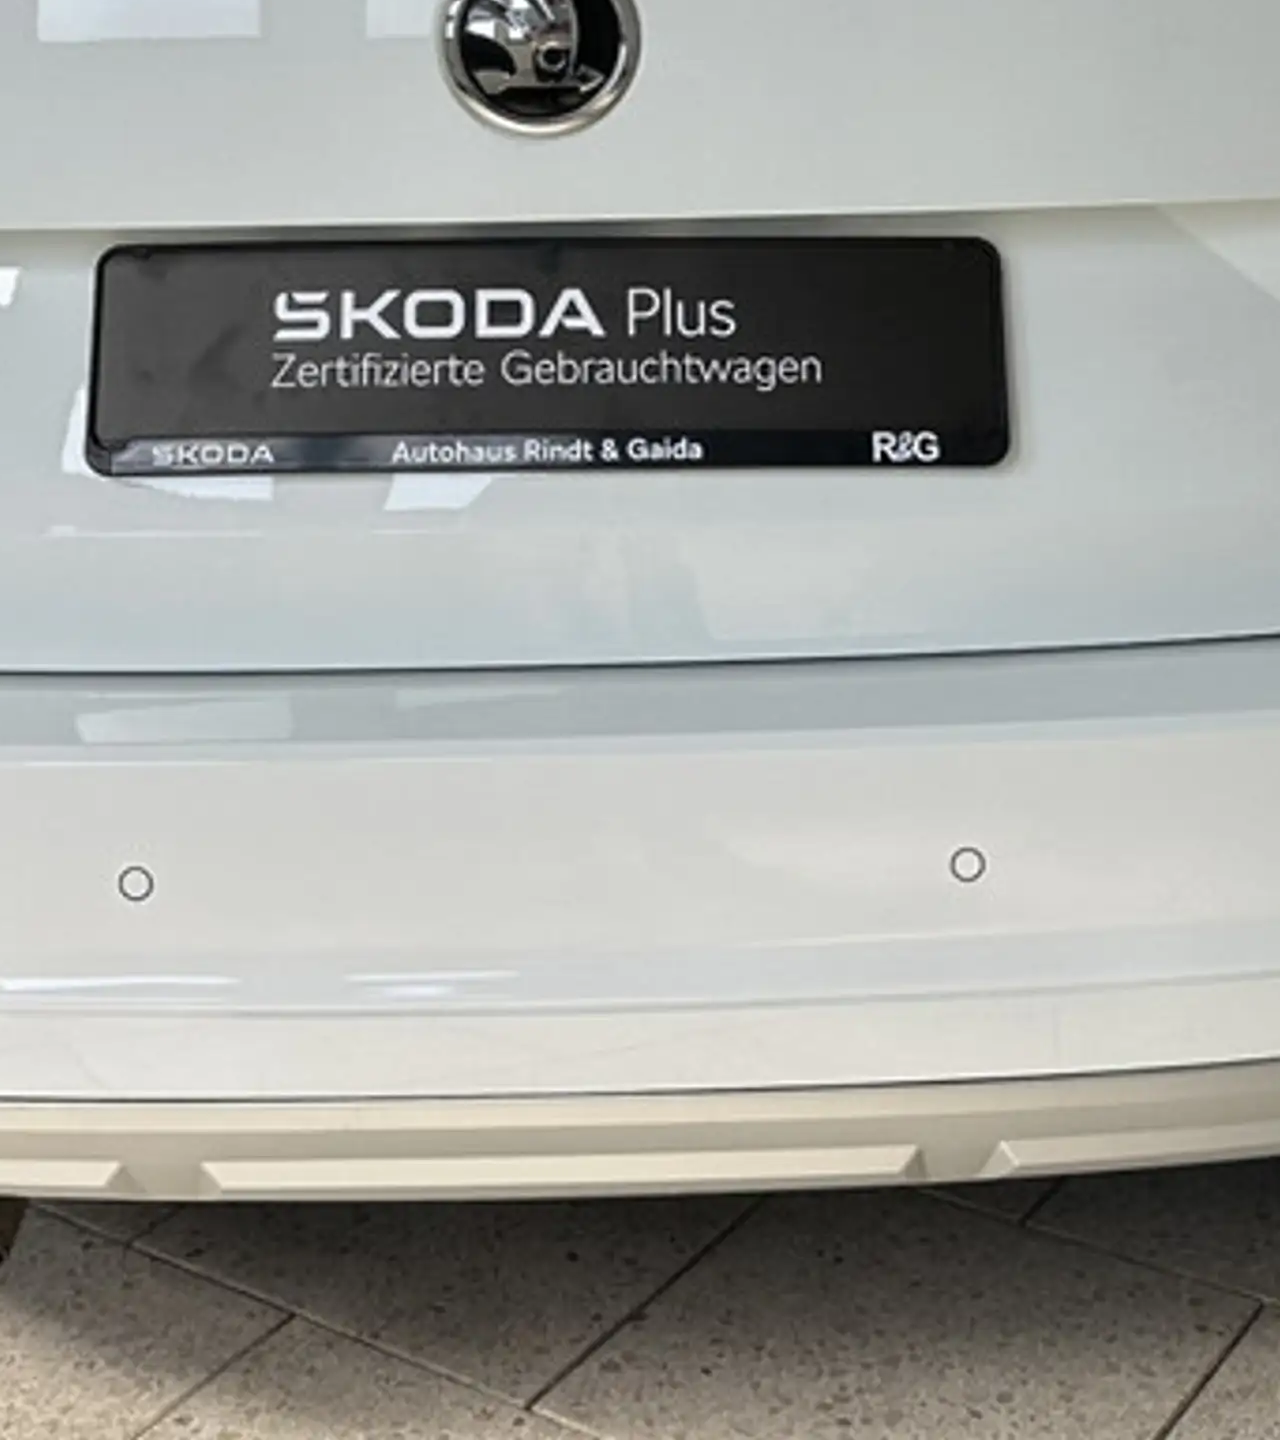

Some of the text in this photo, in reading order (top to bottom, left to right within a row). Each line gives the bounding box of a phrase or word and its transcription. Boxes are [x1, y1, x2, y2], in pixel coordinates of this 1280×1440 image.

[626, 286, 737, 338] Plus
[271, 347, 823, 392] Zertifizierte Gebrauchtwagen
[391, 436, 704, 464] Autohaus Rindt & Gaida
[871, 430, 941, 463] R&G
